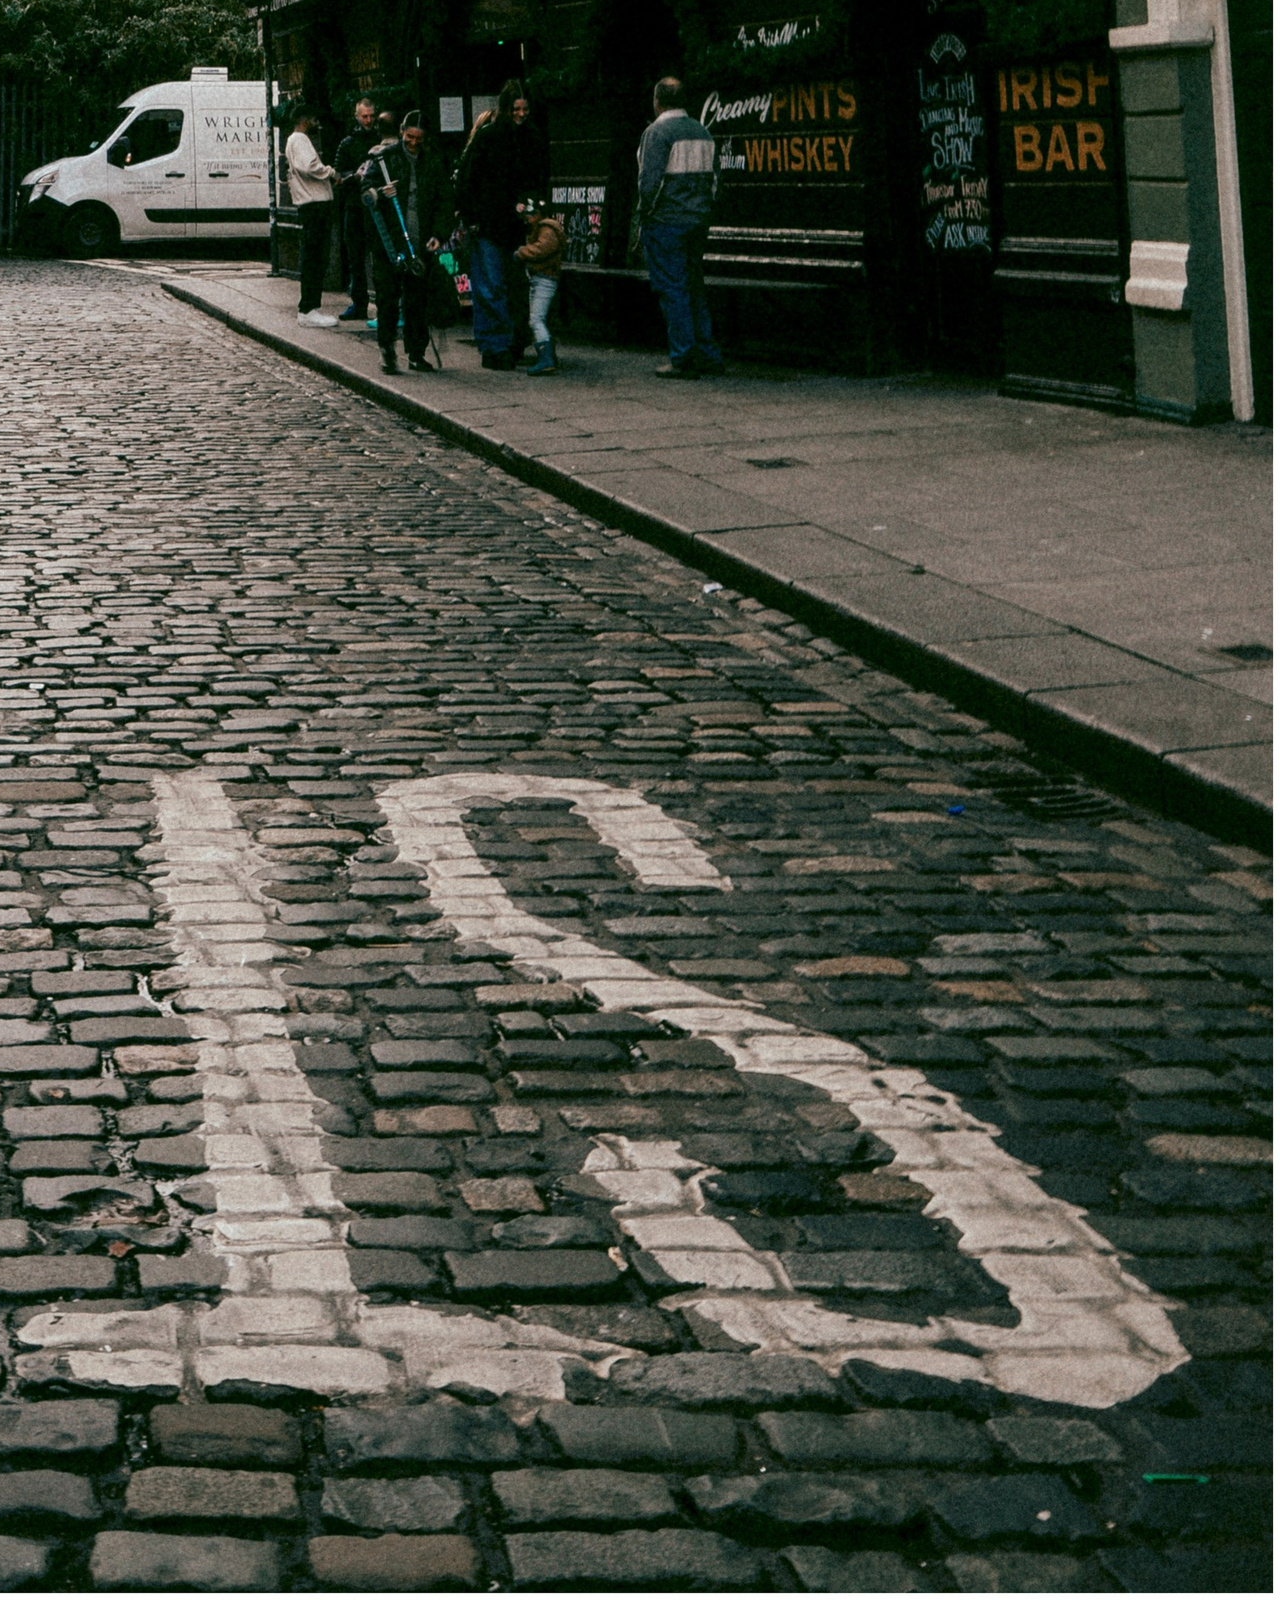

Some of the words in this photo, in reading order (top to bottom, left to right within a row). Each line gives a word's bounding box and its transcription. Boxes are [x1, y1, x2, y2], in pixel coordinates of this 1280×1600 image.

[205, 116, 268, 128] WRIGH
[700, 91, 773, 129] Creamy
[772, 81, 858, 123] PINTS
[745, 135, 854, 173] WHISKEY
[931, 131, 974, 169] SHOW
[1014, 120, 1107, 172] BAR
[568, 186, 586, 203] DANCE
[587, 186, 606, 203] SHOW
[944, 222, 966, 250] ASK
